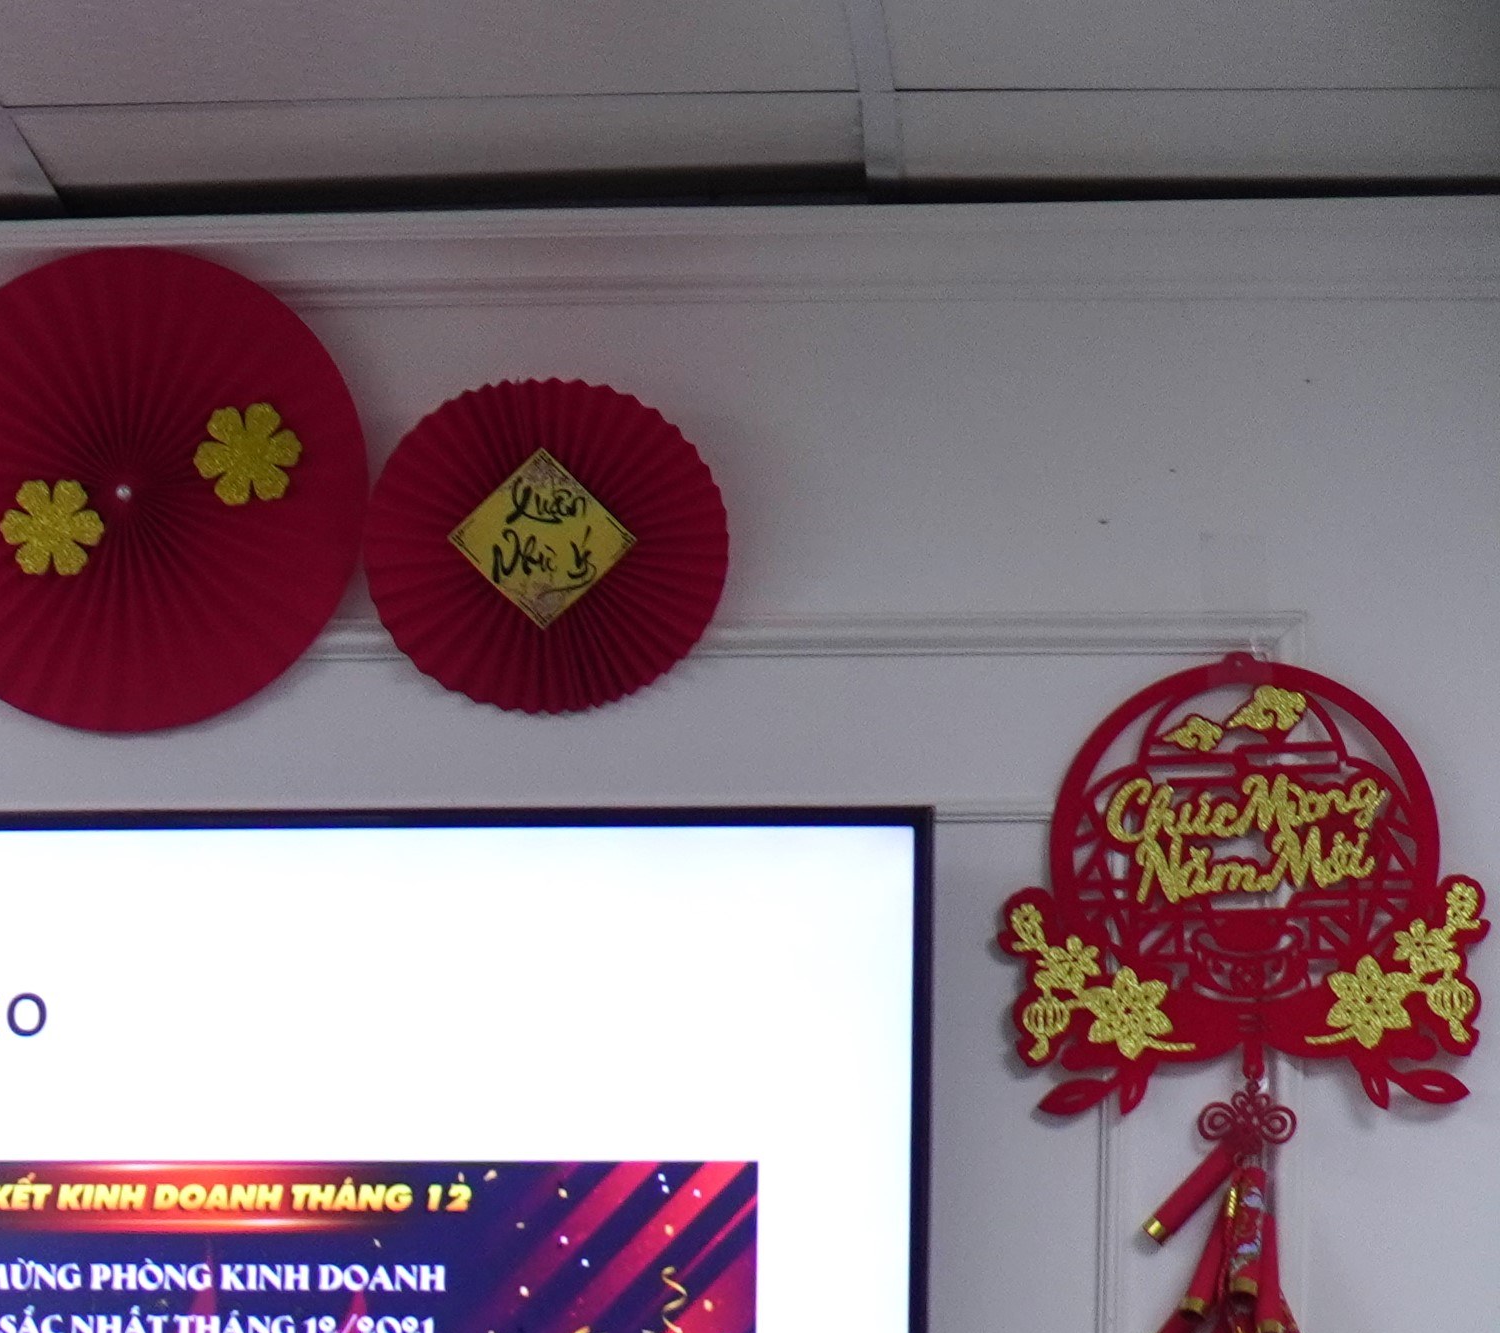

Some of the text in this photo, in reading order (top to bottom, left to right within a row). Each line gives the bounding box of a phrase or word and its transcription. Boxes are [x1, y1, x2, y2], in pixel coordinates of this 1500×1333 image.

[1105, 776, 1246, 845] Chúc
[1136, 832, 1274, 904] Năm
[56, 1183, 148, 1211] KINH
[152, 1183, 284, 1212] DOANH
[290, 1176, 414, 1212] THÁNG
[426, 1182, 474, 1213] 12
[88, 1257, 213, 1292] PHÒNG
[219, 1263, 311, 1292] KINH
[317, 1263, 447, 1292] DOANH
